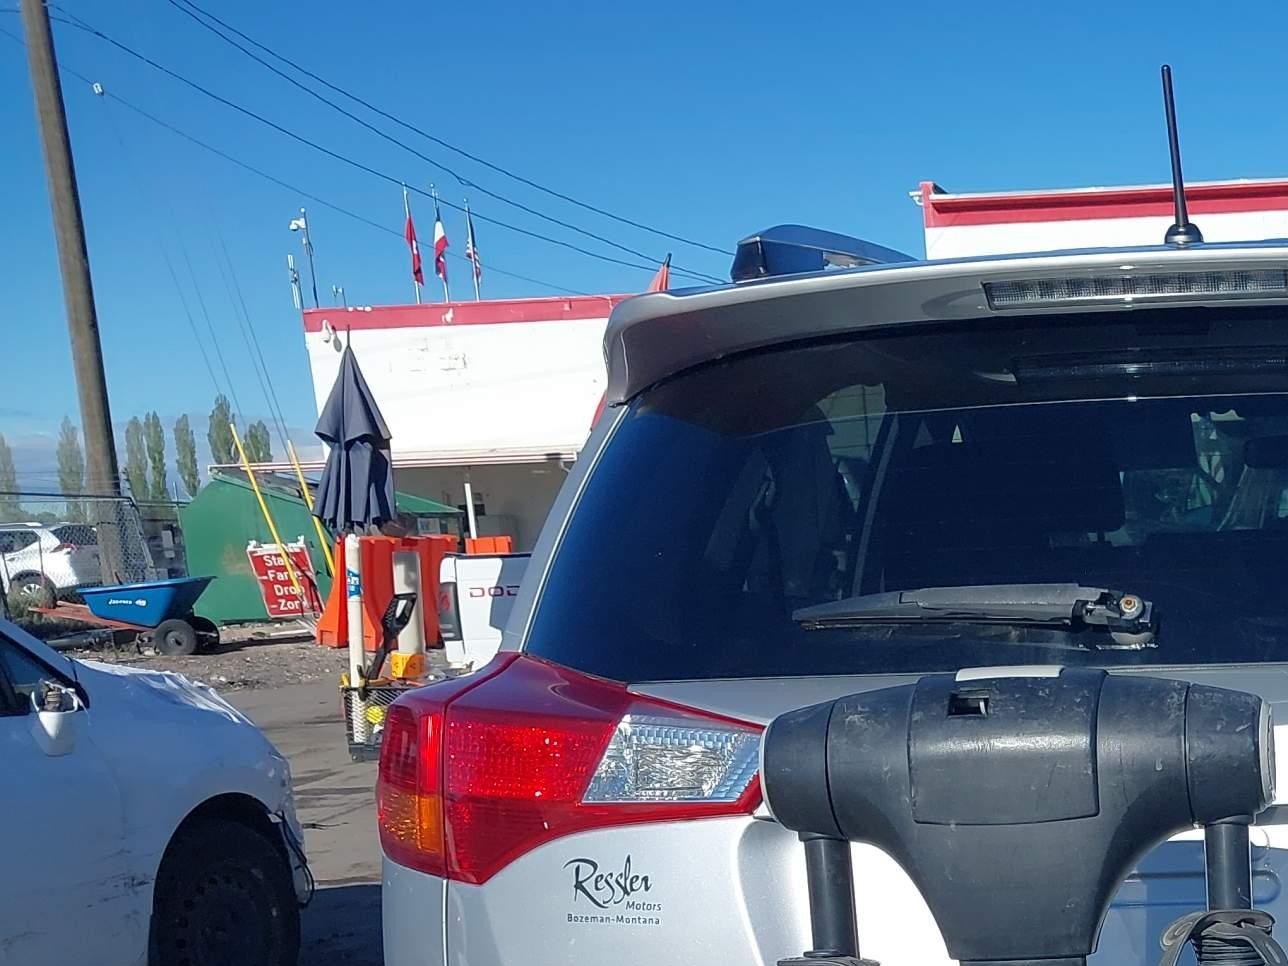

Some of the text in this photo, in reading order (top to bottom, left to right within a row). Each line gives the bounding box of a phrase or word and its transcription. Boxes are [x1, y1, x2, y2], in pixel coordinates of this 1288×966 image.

[469, 585, 520, 598] DOD
[563, 854, 652, 909] Ressler
[625, 900, 662, 911] Motors
[567, 913, 660, 925] Bozeman-Montana
